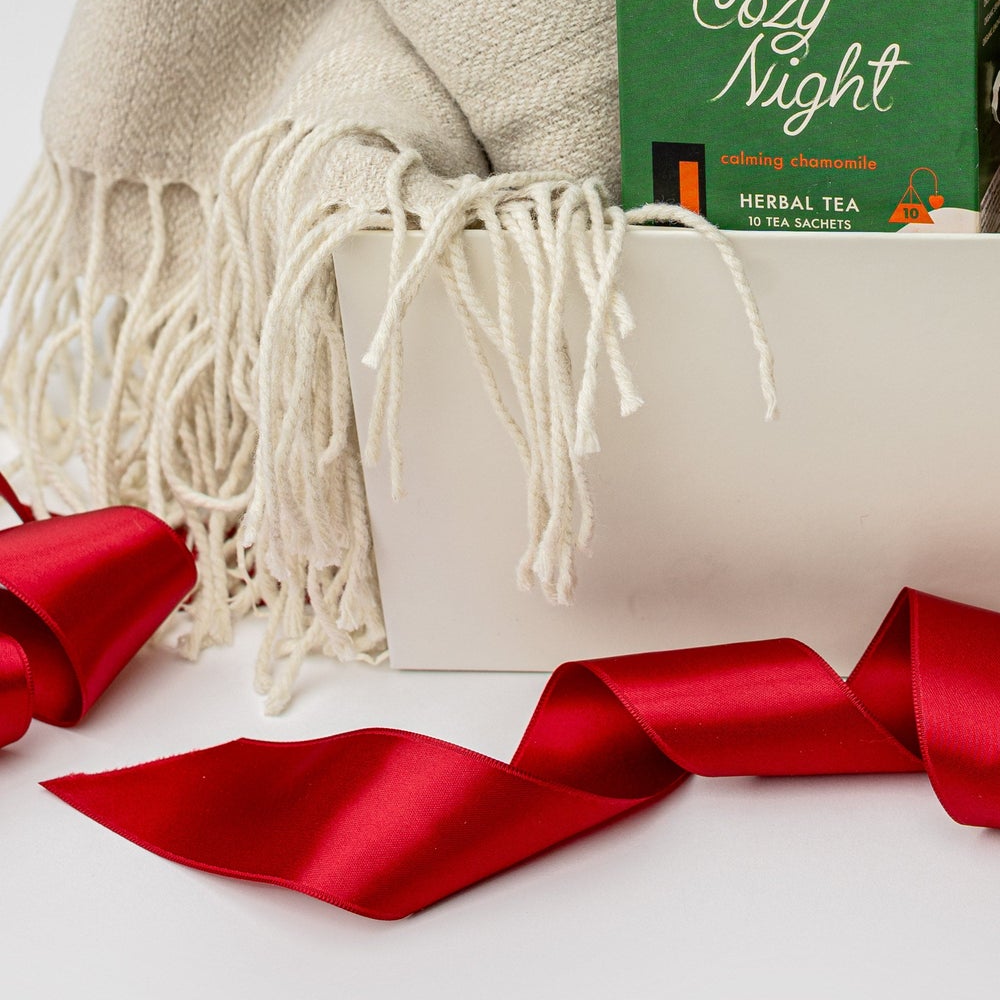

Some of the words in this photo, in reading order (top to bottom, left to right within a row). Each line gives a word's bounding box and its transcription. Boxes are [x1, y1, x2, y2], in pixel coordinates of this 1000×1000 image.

[710, 32, 911, 136] Night
[720, 151, 784, 170] calming
[790, 153, 878, 171] chamomile
[740, 193, 817, 212] HERBAL
[822, 196, 860, 213] TEA
[903, 207, 919, 219] 10
[748, 215, 761, 228] 10
[765, 216, 790, 228] TEA
[794, 216, 852, 230] SACHETS
